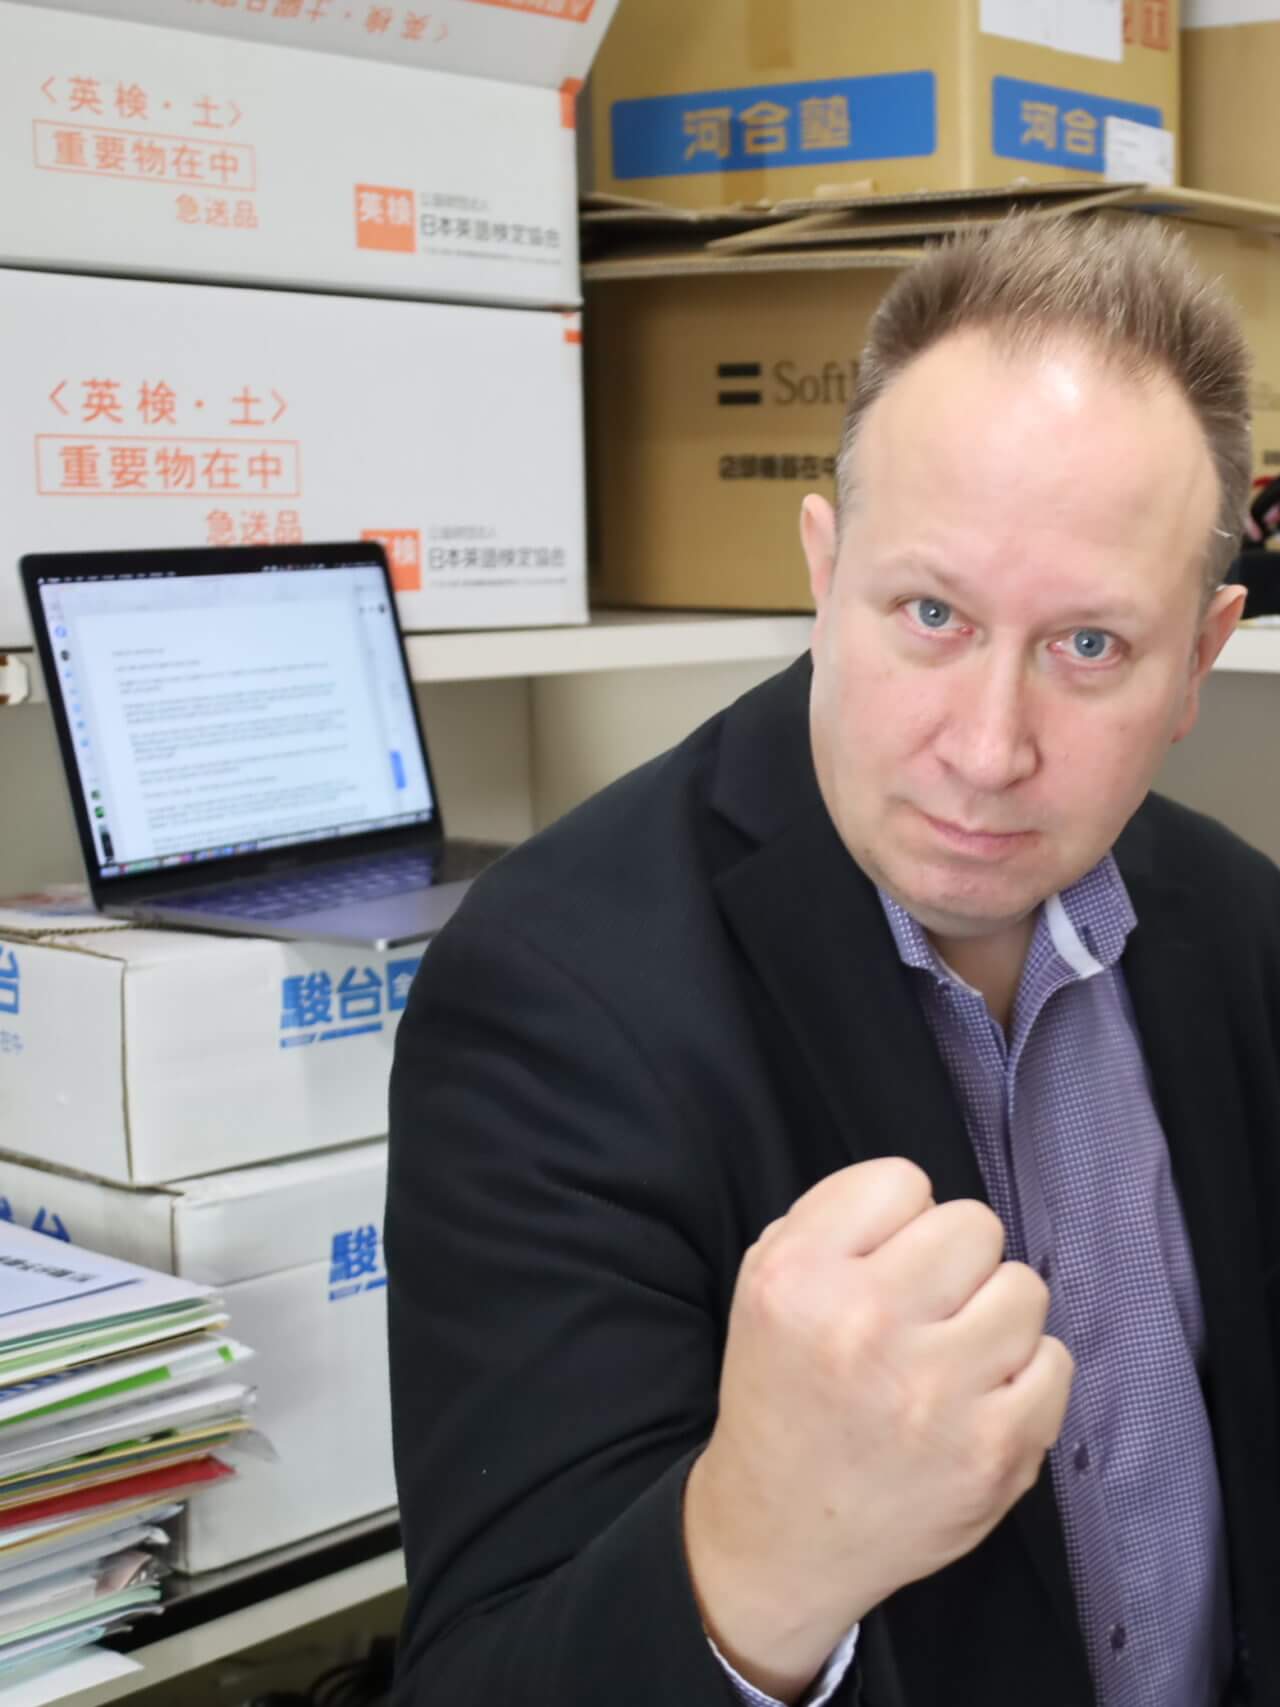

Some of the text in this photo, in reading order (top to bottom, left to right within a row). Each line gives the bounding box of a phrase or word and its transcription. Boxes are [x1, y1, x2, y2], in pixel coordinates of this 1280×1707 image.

[682, 96, 852, 160] 河合塾
[54, 130, 240, 183] 重要物在中
[175, 193, 259, 229] 急送品
[57, 444, 284, 490] 重要物在中
[205, 508, 304, 547] 急送品
[280, 964, 384, 1030] 駿台
